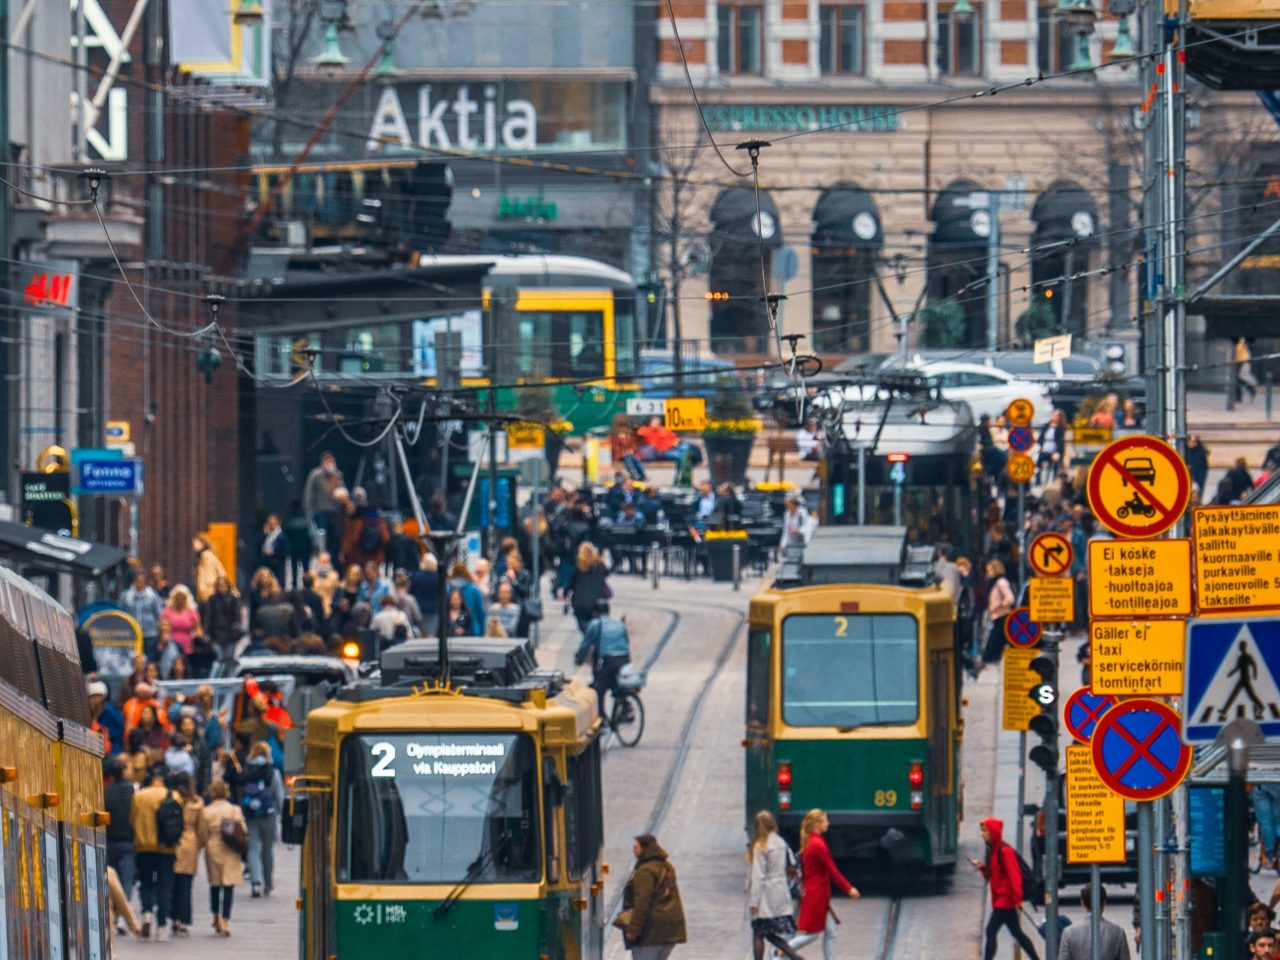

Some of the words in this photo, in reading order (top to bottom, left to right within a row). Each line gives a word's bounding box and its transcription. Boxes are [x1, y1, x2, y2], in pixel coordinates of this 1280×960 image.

[368, 84, 537, 150] Aktia
[667, 407, 680, 427] 10
[1199, 540, 1237, 551] sallittu
[1104, 548, 1114, 560] Ei
[1120, 547, 1156, 560] koske
[1203, 566, 1256, 579] purkaville
[1204, 578, 1269, 593] ajoneuvoille
[834, 617, 848, 637] 2
[1094, 627, 1129, 640] Gäller
[1136, 628, 1147, 641] ej
[1094, 659, 1183, 672] -servicekörnin
[371, 742, 396, 777] 2
[875, 790, 897, 807] 89
